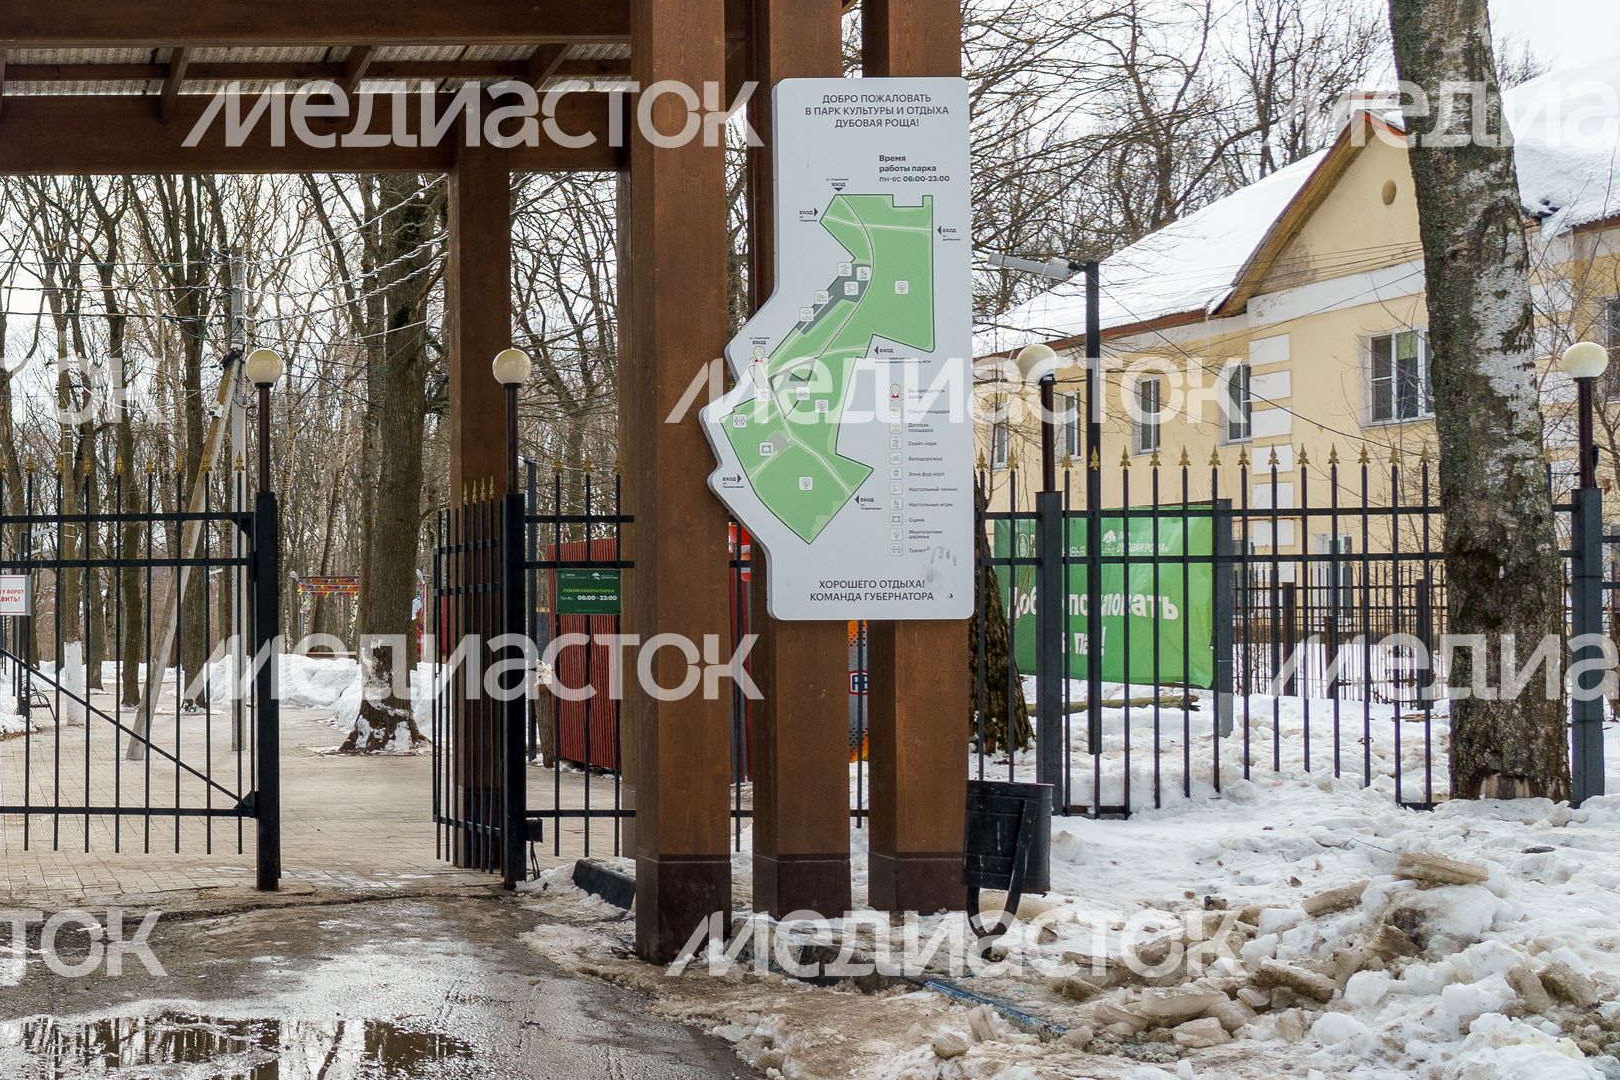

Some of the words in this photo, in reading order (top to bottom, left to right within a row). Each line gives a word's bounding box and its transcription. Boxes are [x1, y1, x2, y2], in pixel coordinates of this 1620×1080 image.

[822, 94, 858, 104] ДОБРО
[860, 94, 932, 103] ПОЖАЛОВАТЬ
[805, 107, 812, 116] В
[814, 107, 841, 116] ПАРК
[843, 106, 895, 116] КУЛЬТУРЫ
[897, 106, 904, 115] И
[906, 105, 949, 116] ОТДЫХА
[835, 119, 883, 129] ДУБОВАЯ
[885, 118, 920, 128] РОЩА!
[879, 154, 907, 163] Время
[879, 165, 910, 173] работы
[819, 579, 877, 589] ХОРОШЕГО
[879, 579, 926, 590] ОТДЫХА!
[810, 592, 863, 603] КОМАНДА
[864, 592, 934, 602] ГУБЕРНАТОРА
